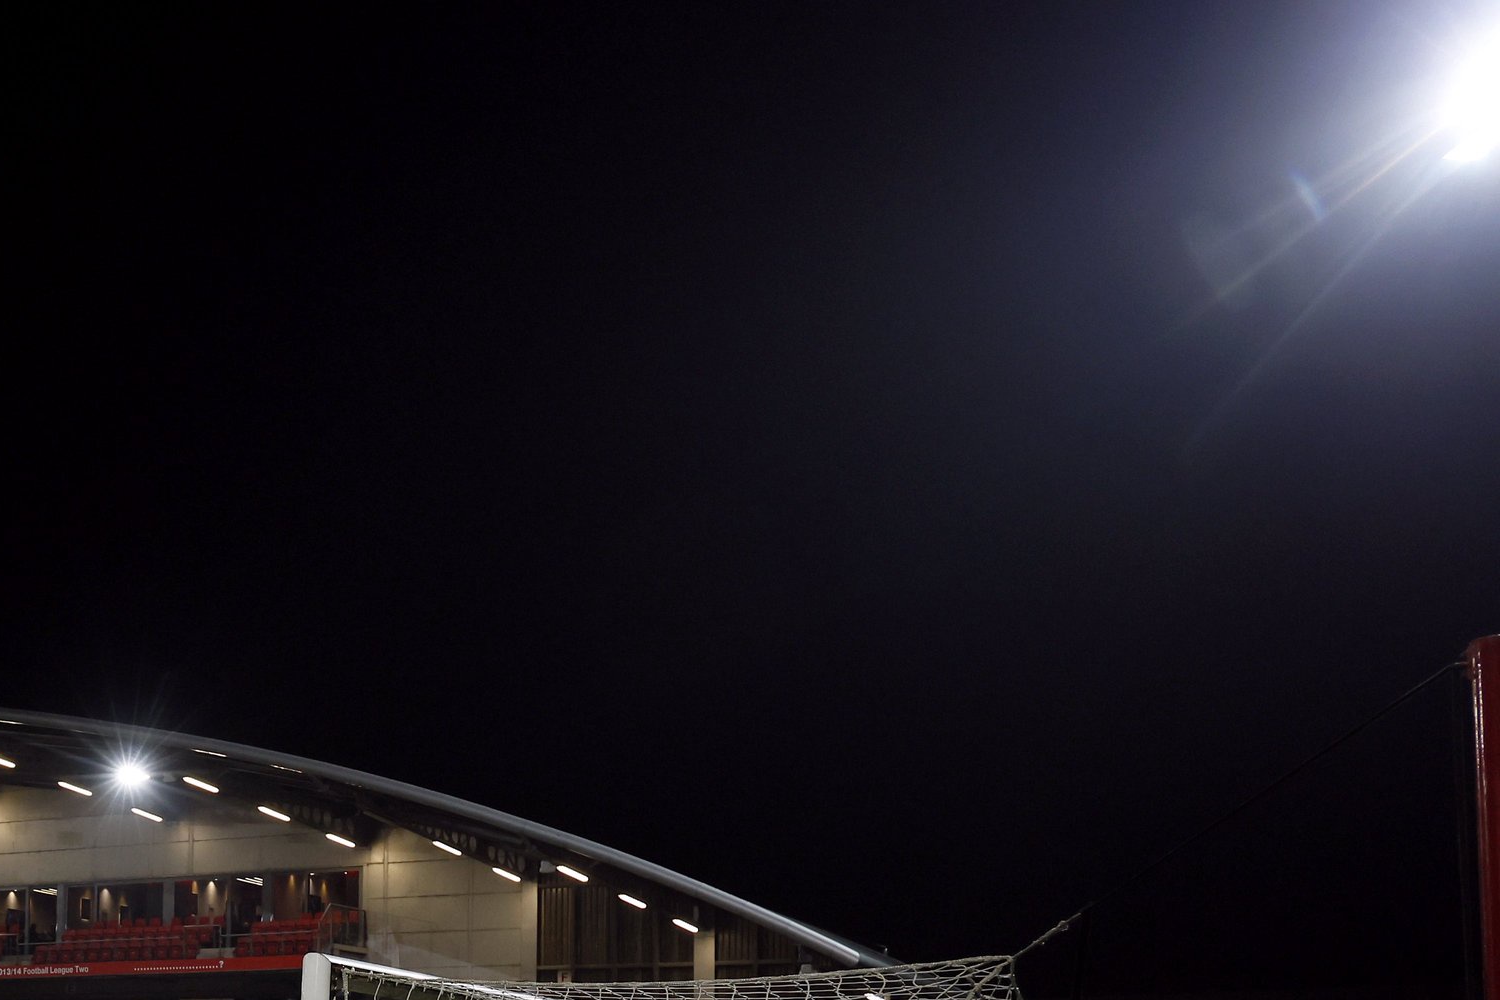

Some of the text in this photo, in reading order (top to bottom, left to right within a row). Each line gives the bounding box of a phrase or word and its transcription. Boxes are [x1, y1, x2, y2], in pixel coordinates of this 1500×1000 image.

[23, 966, 49, 975] Football
[50, 965, 74, 976] League
[75, 965, 89, 974] Two
